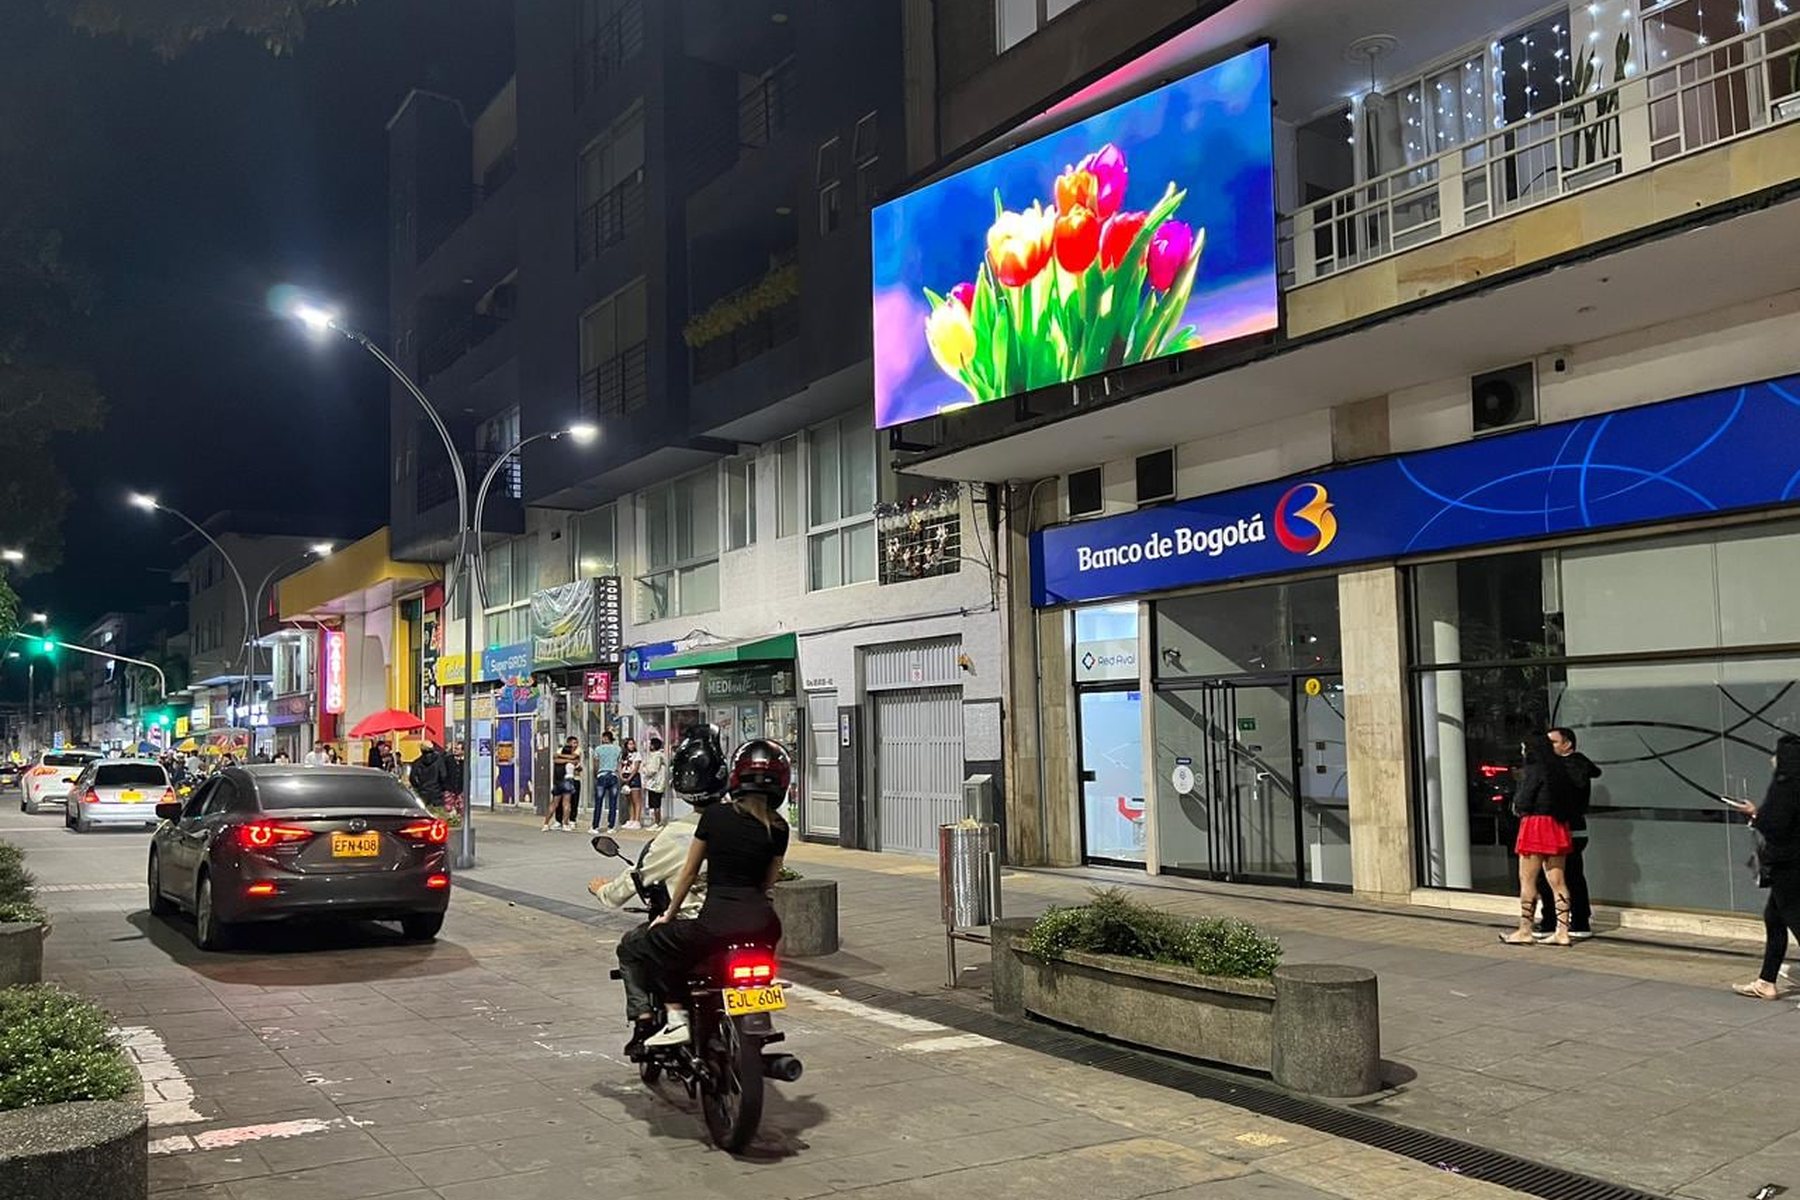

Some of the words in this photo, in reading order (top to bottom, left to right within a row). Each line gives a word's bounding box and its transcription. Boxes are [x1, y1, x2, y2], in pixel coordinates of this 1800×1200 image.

[1077, 542, 1142, 571] Banco
[1145, 532, 1173, 560] de
[1175, 513, 1266, 557] Bogotá
[330, 635, 341, 708] CASINO
[334, 839, 355, 852] EFN
[727, 993, 753, 1009] EJL
[758, 989, 783, 1006] 60H
